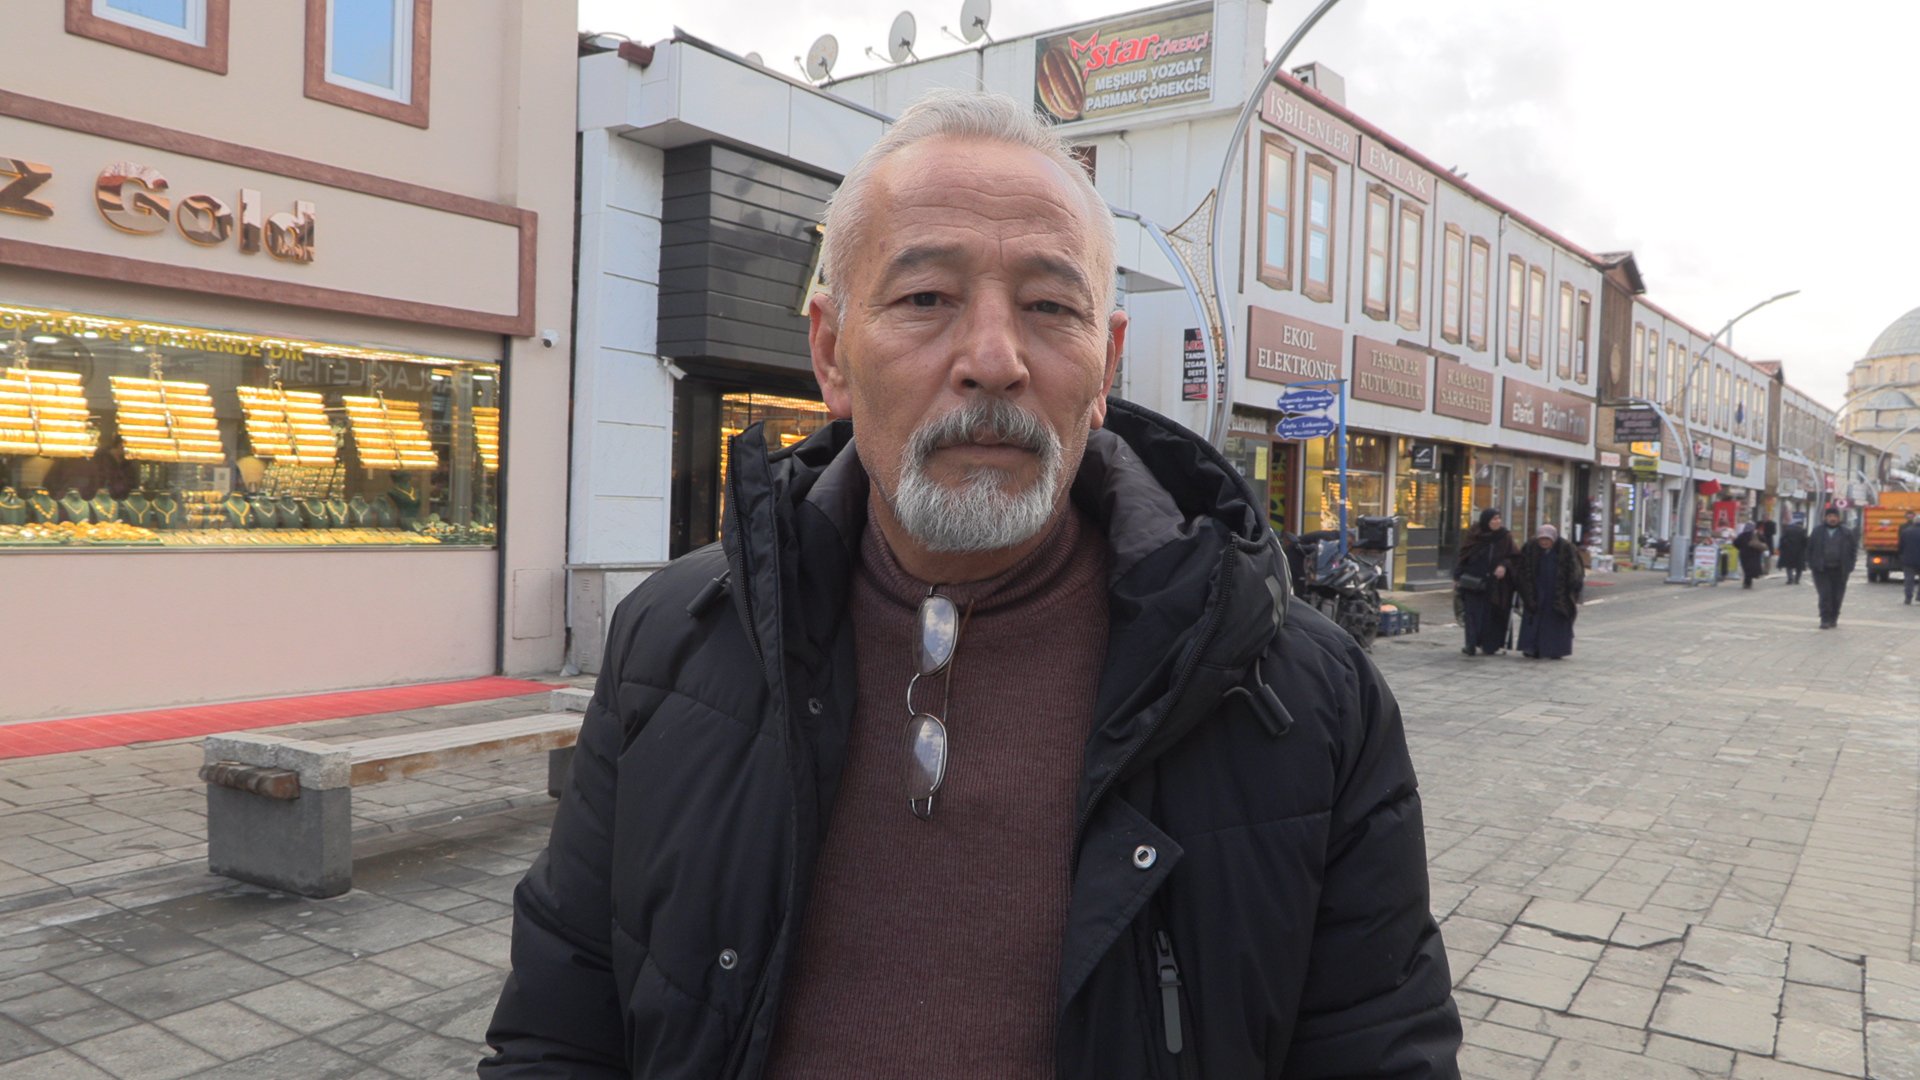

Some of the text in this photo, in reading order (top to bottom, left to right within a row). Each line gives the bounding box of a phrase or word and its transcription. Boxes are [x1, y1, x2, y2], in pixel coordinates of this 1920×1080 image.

[1086, 30, 1209, 70] star ÇÖREKÇİ
[1095, 58, 1204, 91] MEŞHUR YOZGAT
[1086, 90, 1138, 112] PARMAK
[1270, 91, 1427, 194] İŞBİLENLER EMLAK
[95, 161, 316, 264] Gold
[1283, 325, 1317, 351] EKOL
[1257, 347, 1337, 381] ELEKTRONİK
[1360, 371, 1423, 400] KUYUMCULUK
